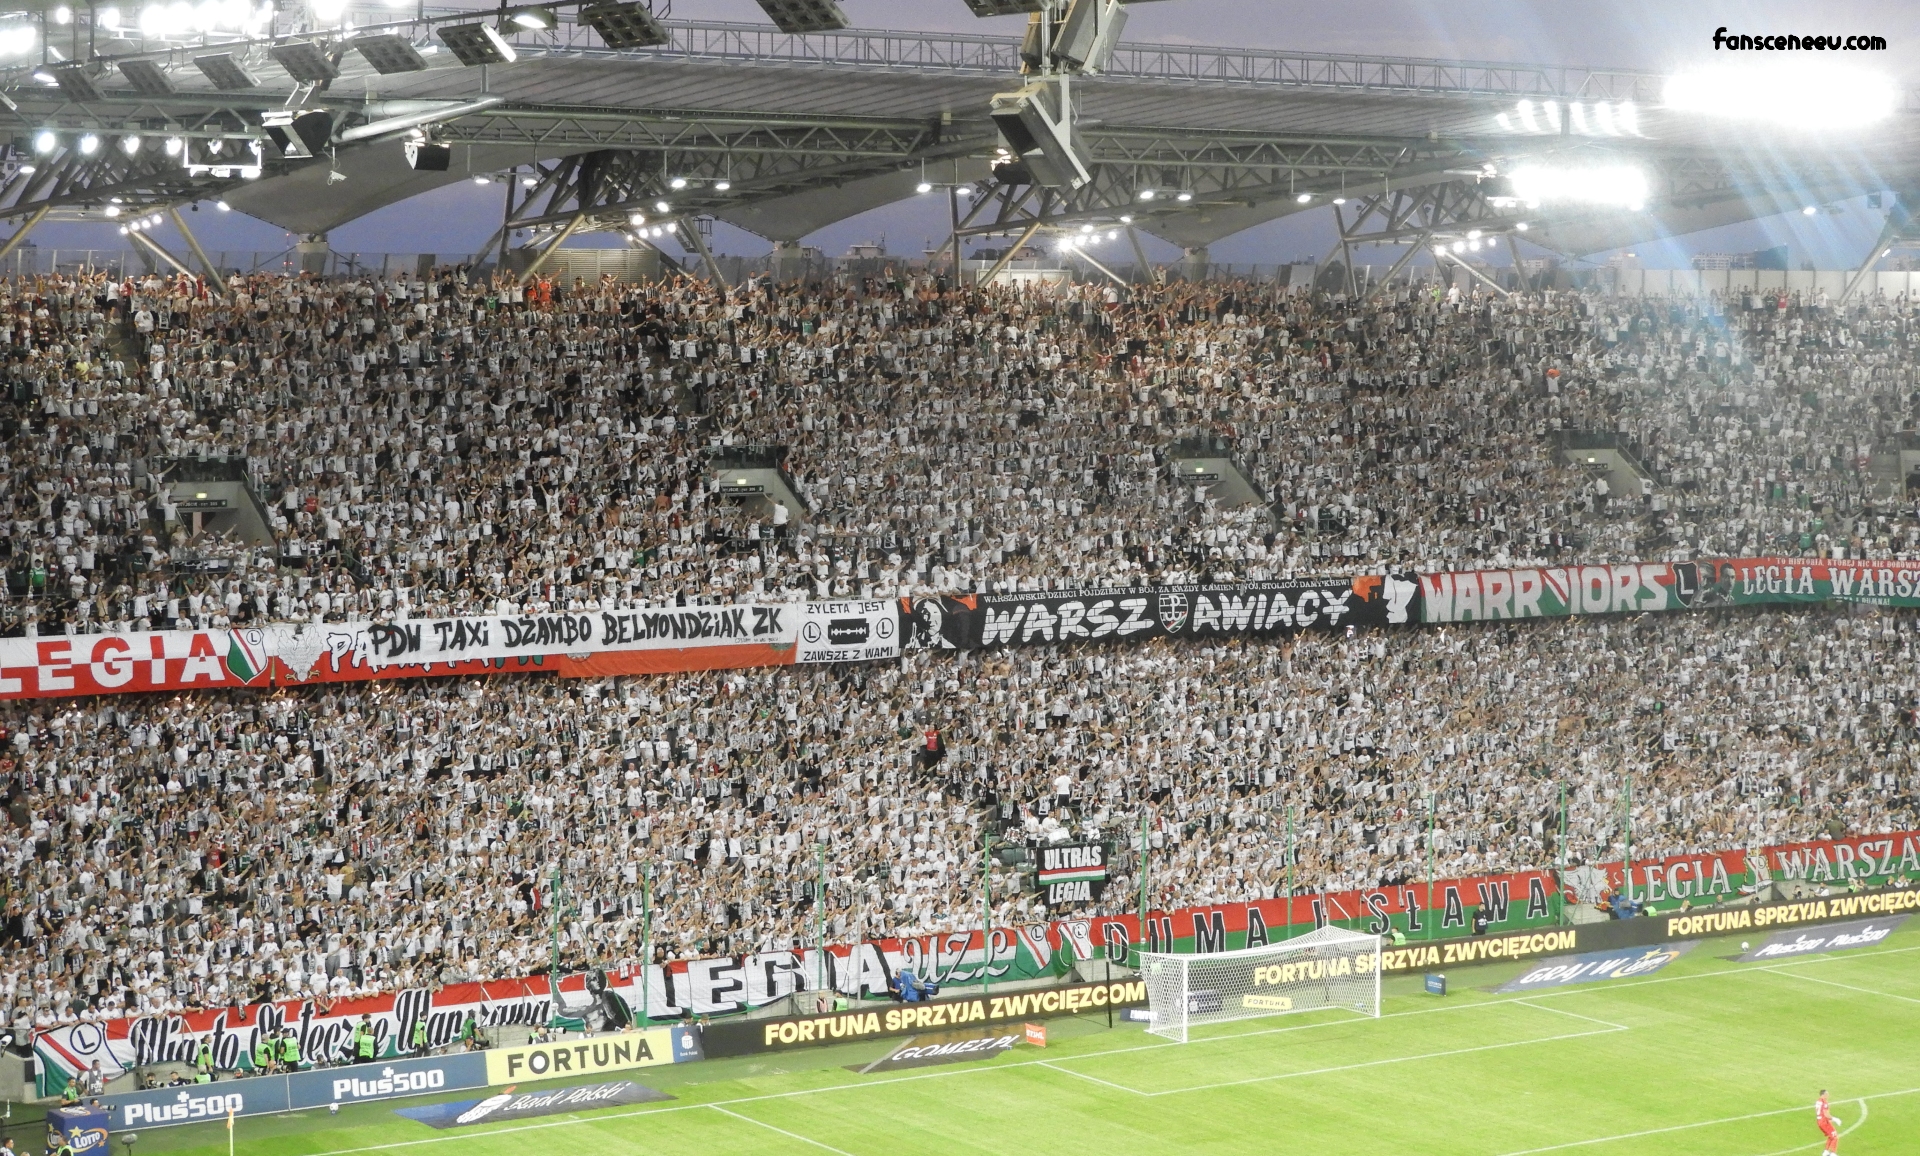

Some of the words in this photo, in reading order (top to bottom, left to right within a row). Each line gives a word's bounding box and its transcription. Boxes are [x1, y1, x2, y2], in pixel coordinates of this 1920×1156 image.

[984, 592, 1046, 603] WARSZAWSKIE
[1048, 590, 1076, 599] DZIECI
[1158, 584, 1171, 593] ZA
[1678, 569, 1694, 595] L
[1742, 566, 1815, 595] LEGIA
[858, 600, 886, 614] JEST
[752, 607, 783, 637] ZK
[803, 650, 848, 661] ZAWSZE
[853, 649, 860, 659] Z
[865, 647, 892, 658] WAMI
[1044, 845, 1102, 870] ULTRAS
[1623, 857, 1732, 903] LEGIA
[1776, 837, 1920, 881] WARSZA
[1049, 880, 1091, 904] LEGIA
[1668, 911, 1751, 937] FORTUNA
[1755, 901, 1827, 926] SPRZYJA
[1254, 957, 1350, 986] FORTUNA
[1355, 943, 1440, 974] SPRZYJA
[1443, 930, 1576, 964] ZWYCIĘZCOM
[1520, 962, 1590, 984] GRAJ
[1589, 957, 1630, 976] W
[642, 943, 890, 1018] LEGIA
[765, 1015, 881, 1046] FORTUNA
[886, 1001, 985, 1031] SPRZYJA
[990, 981, 1146, 1019] ZWYCIĘZCOM
[508, 1038, 654, 1077] FORTUNA
[892, 1035, 1020, 1060] GOMEZ.PL
[333, 1067, 445, 1100] Plus500
[124, 1091, 243, 1125] Plus500
[504, 1090, 564, 1111] Bank
[74, 1131, 101, 1149] LOTTO
